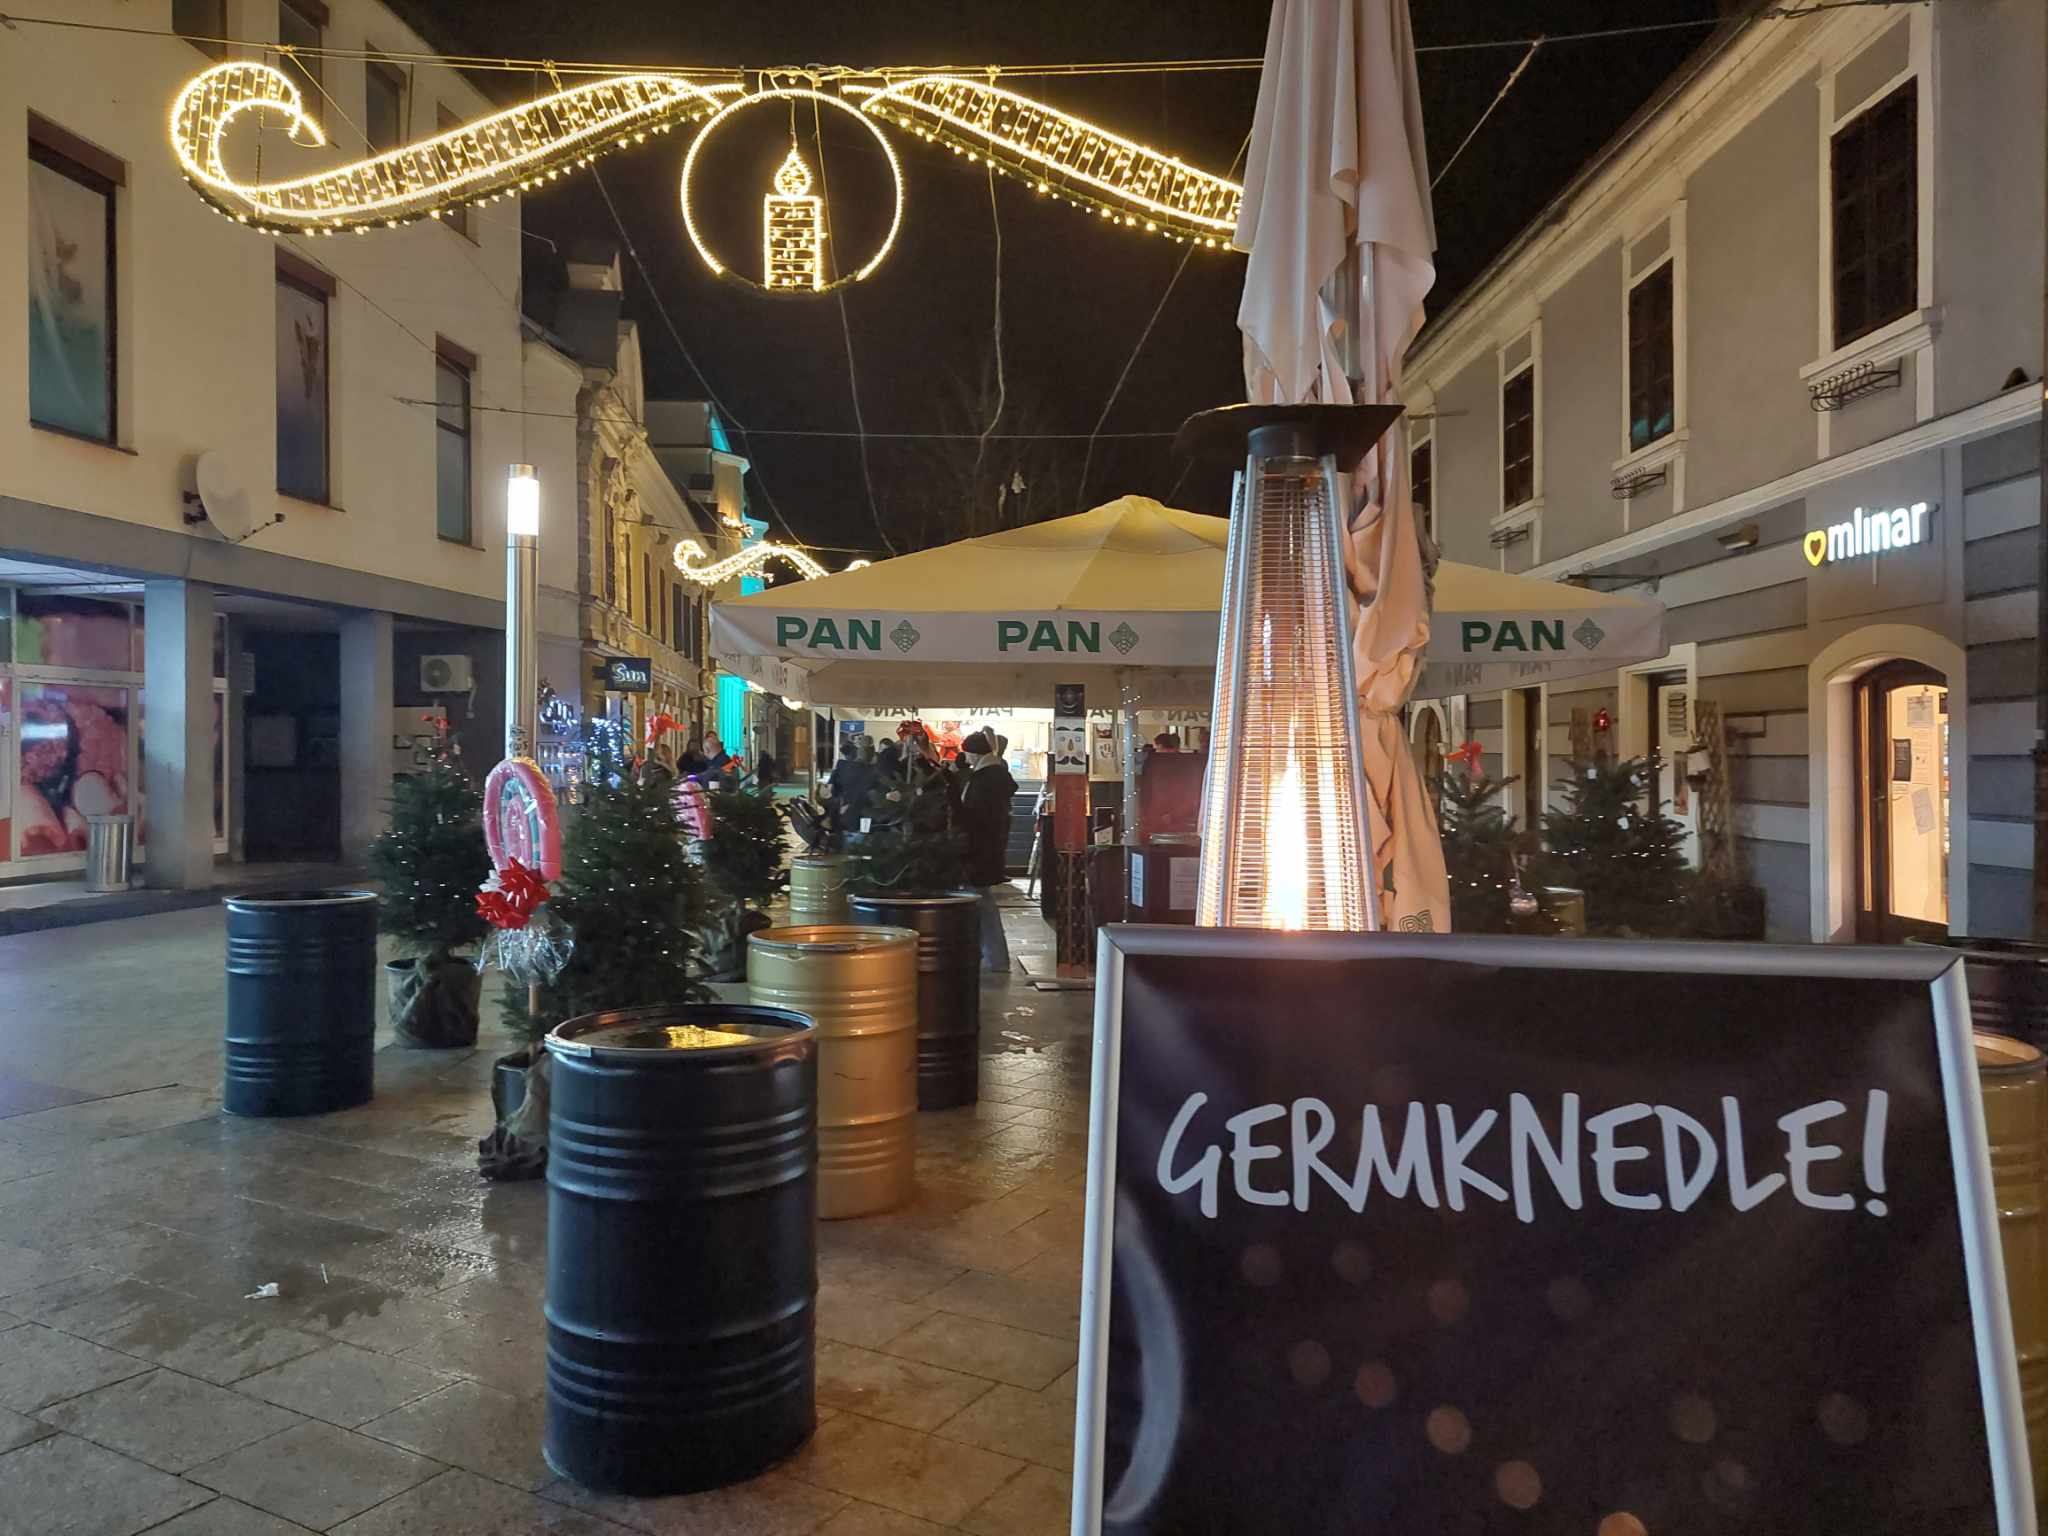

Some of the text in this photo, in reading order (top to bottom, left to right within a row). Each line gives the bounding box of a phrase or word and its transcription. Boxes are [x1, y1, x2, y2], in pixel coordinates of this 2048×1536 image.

[1827, 501, 1928, 562] mlinar
[776, 617, 881, 651] PAN
[998, 620, 1101, 653] PAN
[1462, 619, 1566, 652] PAN
[1156, 1089, 1889, 1223] GERMKNEDLE!
